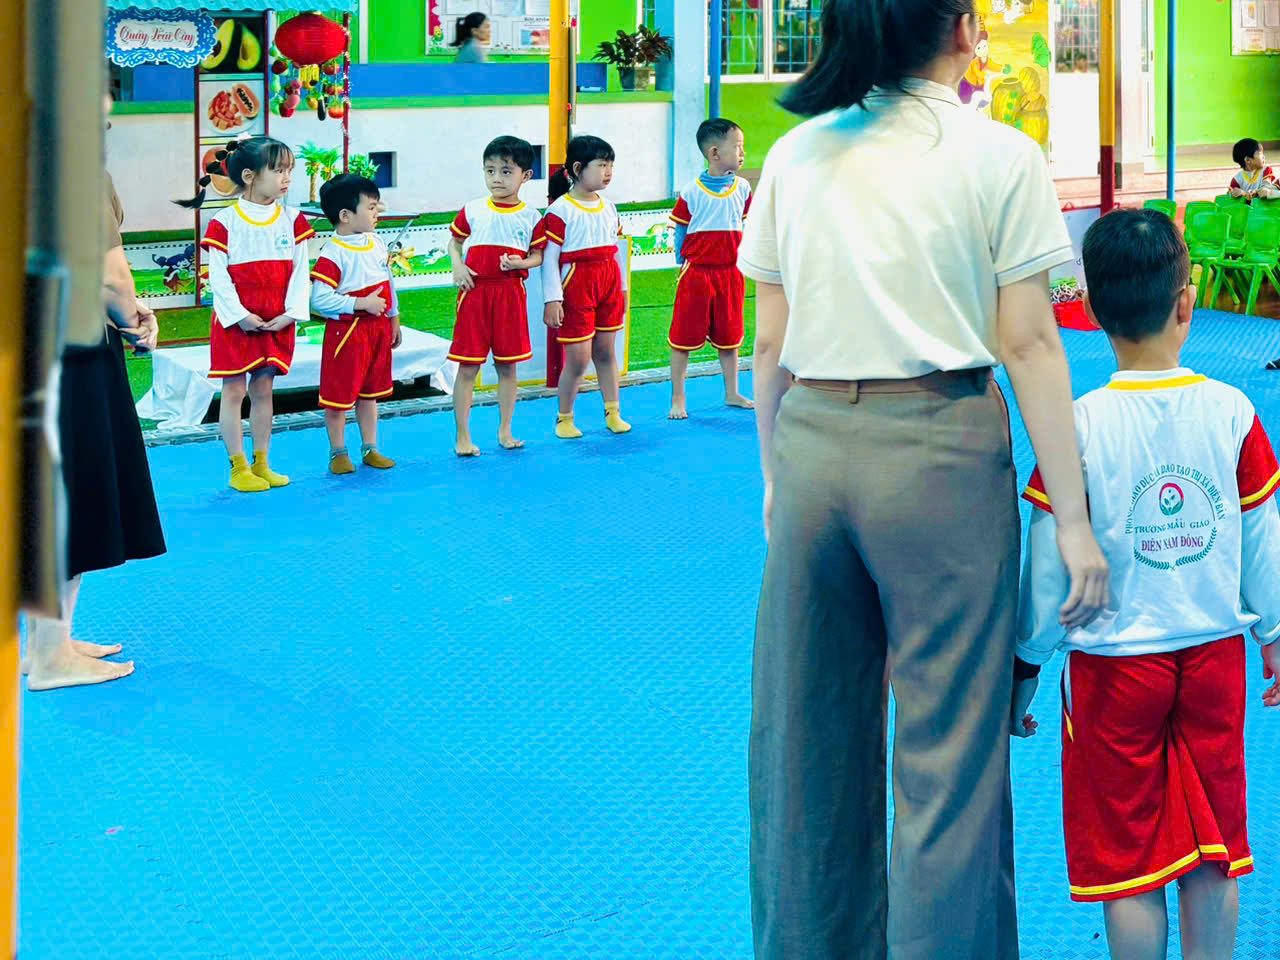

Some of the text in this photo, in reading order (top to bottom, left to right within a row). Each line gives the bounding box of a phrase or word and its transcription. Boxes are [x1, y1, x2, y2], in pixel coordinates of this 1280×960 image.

[1176, 464, 1190, 477] TẠO
[1142, 538, 1161, 553] ĐIỆN
[1180, 534, 1204, 548] ĐÔNG
